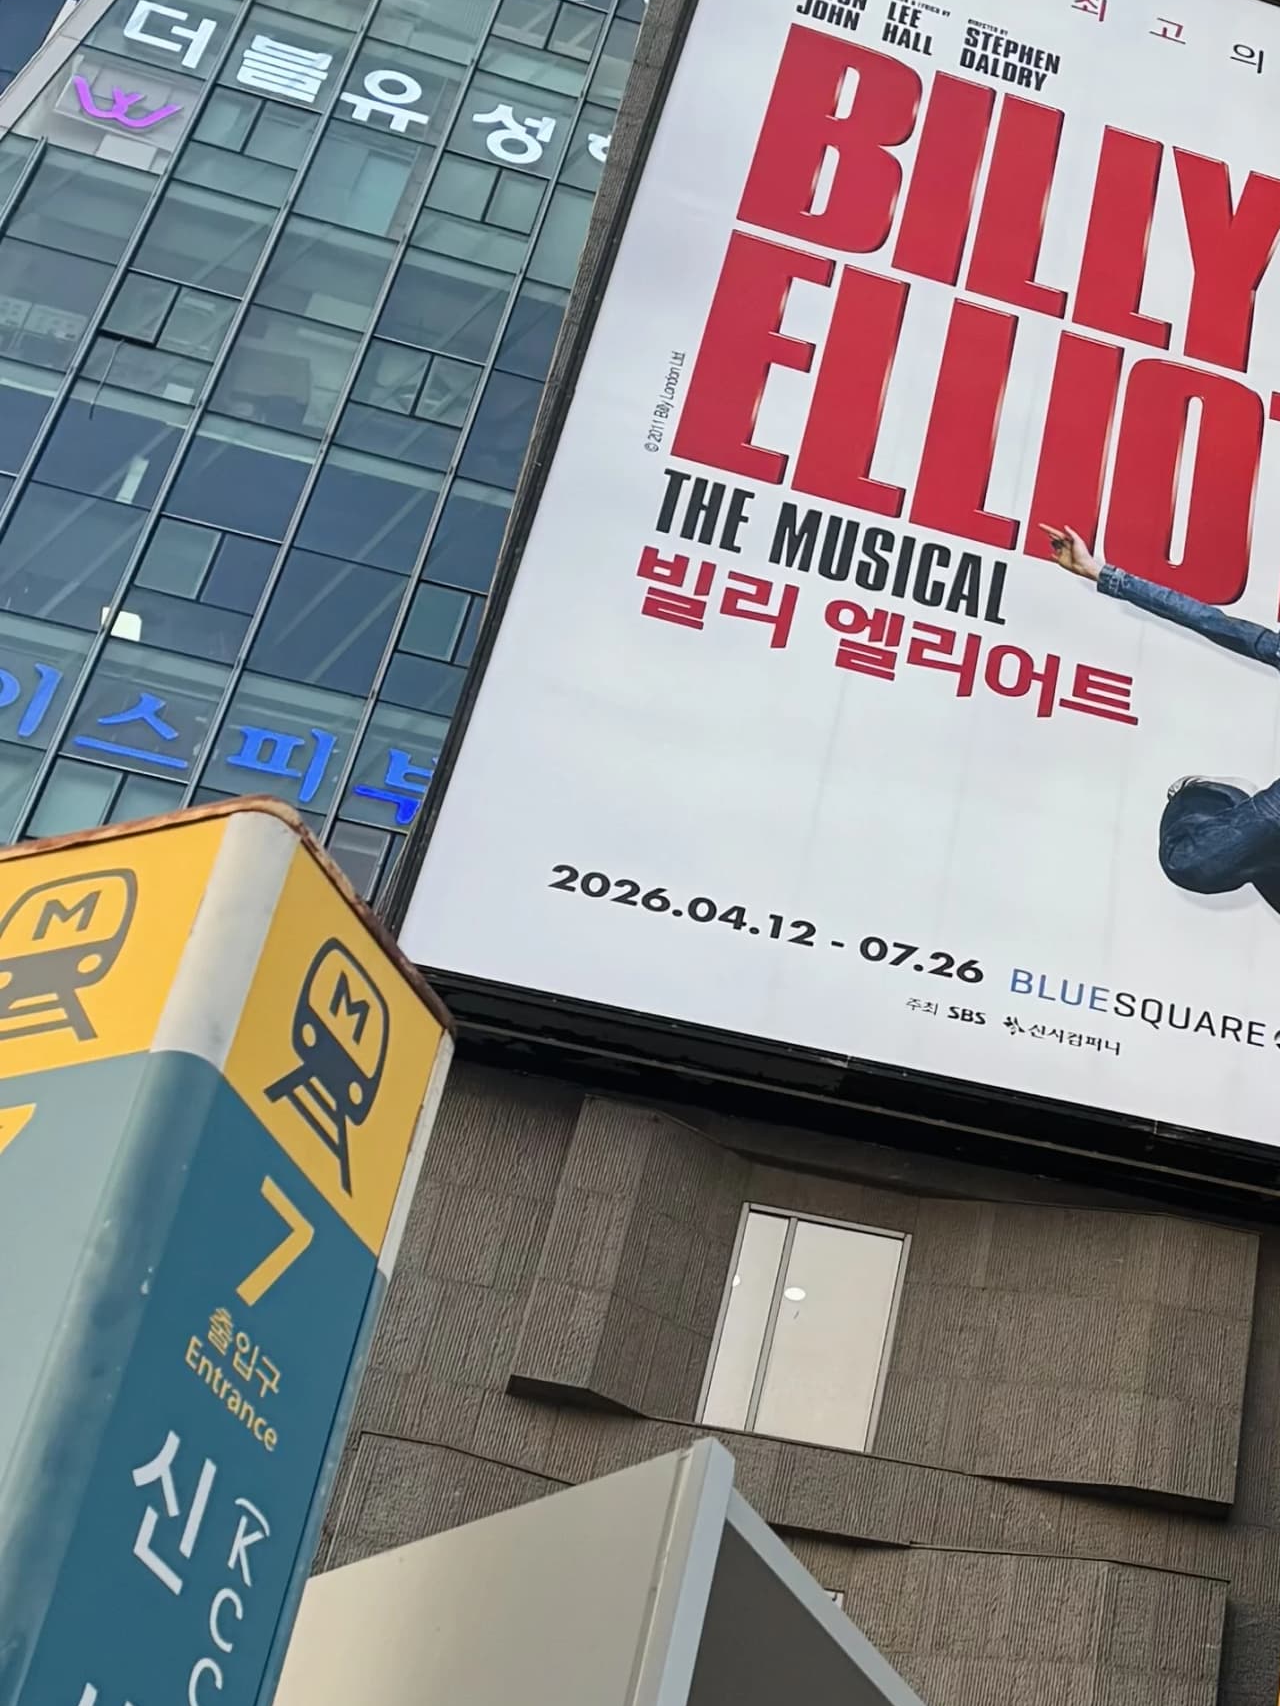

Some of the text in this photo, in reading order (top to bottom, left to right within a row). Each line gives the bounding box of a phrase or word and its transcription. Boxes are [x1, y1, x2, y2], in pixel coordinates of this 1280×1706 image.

[882, 22, 933, 56] HALL
[887, 2, 923, 29] LEE
[964, 26, 1061, 75] STEPHEN
[959, 47, 1048, 92] DALDRY
[647, 419, 665, 444] 2011
[658, 366, 682, 401] London
[655, 468, 1008, 625] THE MUSICAL
[637, 545, 1140, 726] 빌리 엘리어트
[548, 863, 818, 949] 2026.04.12
[859, 934, 986, 986] 07.26
[906, 997, 1121, 1056] 주최 SBS 신시컴퍼니
[1009, 967, 1267, 1049] BLUESQUARE
[236, 1175, 315, 1307] 7
[185, 1335, 279, 1451] Entrance
[207, 1307, 282, 1399] 출입구
